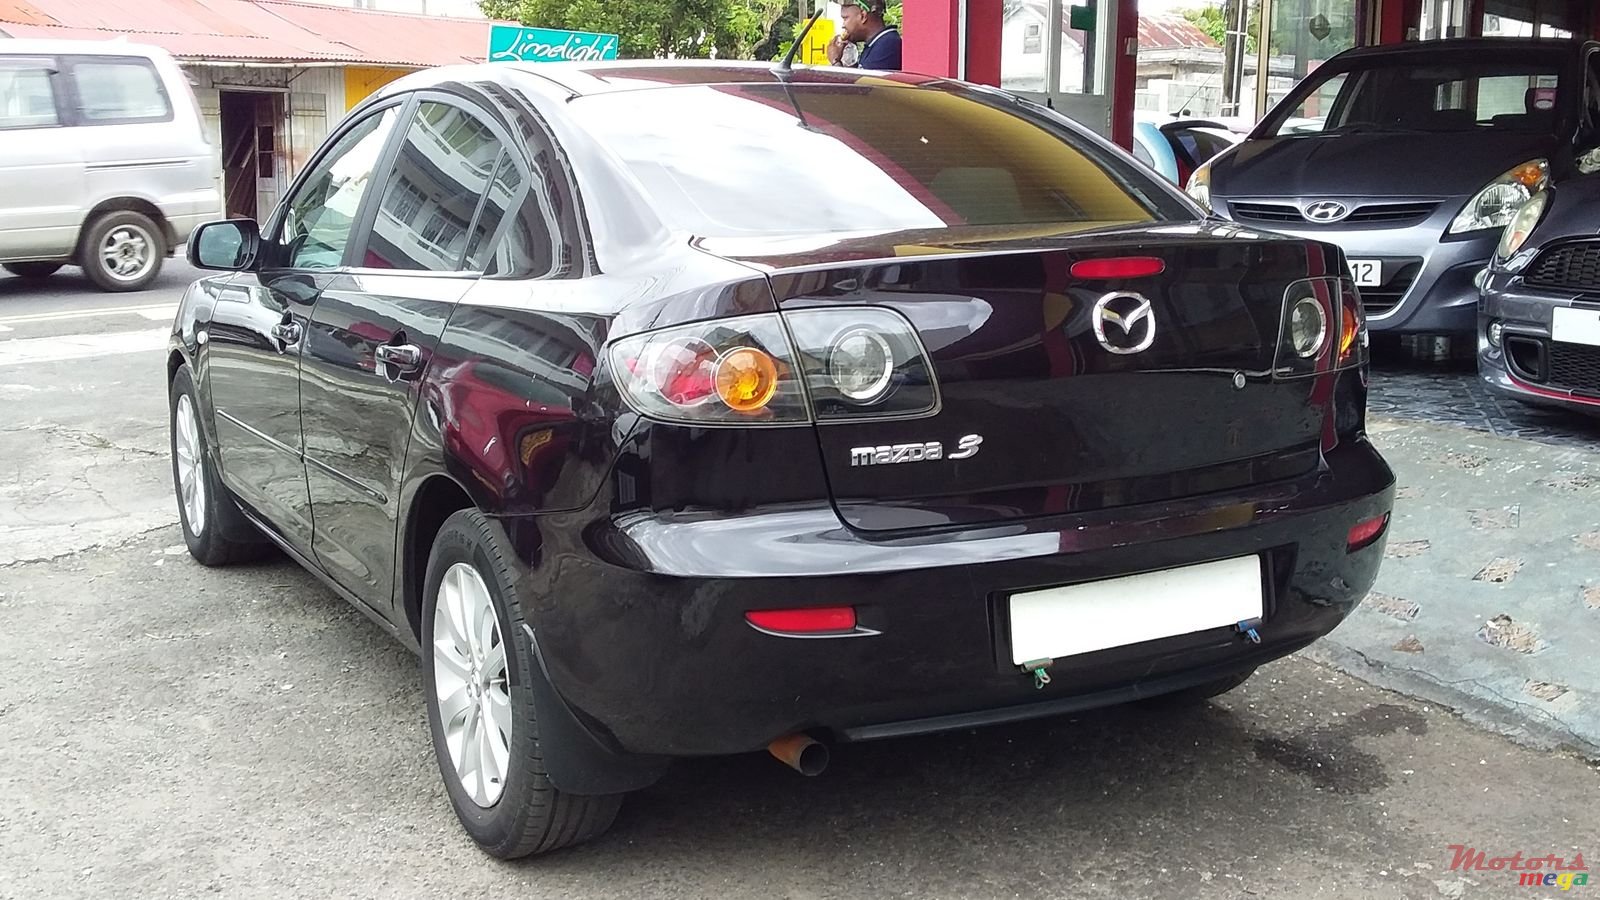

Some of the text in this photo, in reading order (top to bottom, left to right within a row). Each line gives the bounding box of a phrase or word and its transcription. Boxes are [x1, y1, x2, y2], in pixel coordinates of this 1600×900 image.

[492, 30, 615, 61] Limelight
[1352, 263, 1373, 282] 12
[948, 434, 984, 459] 3
